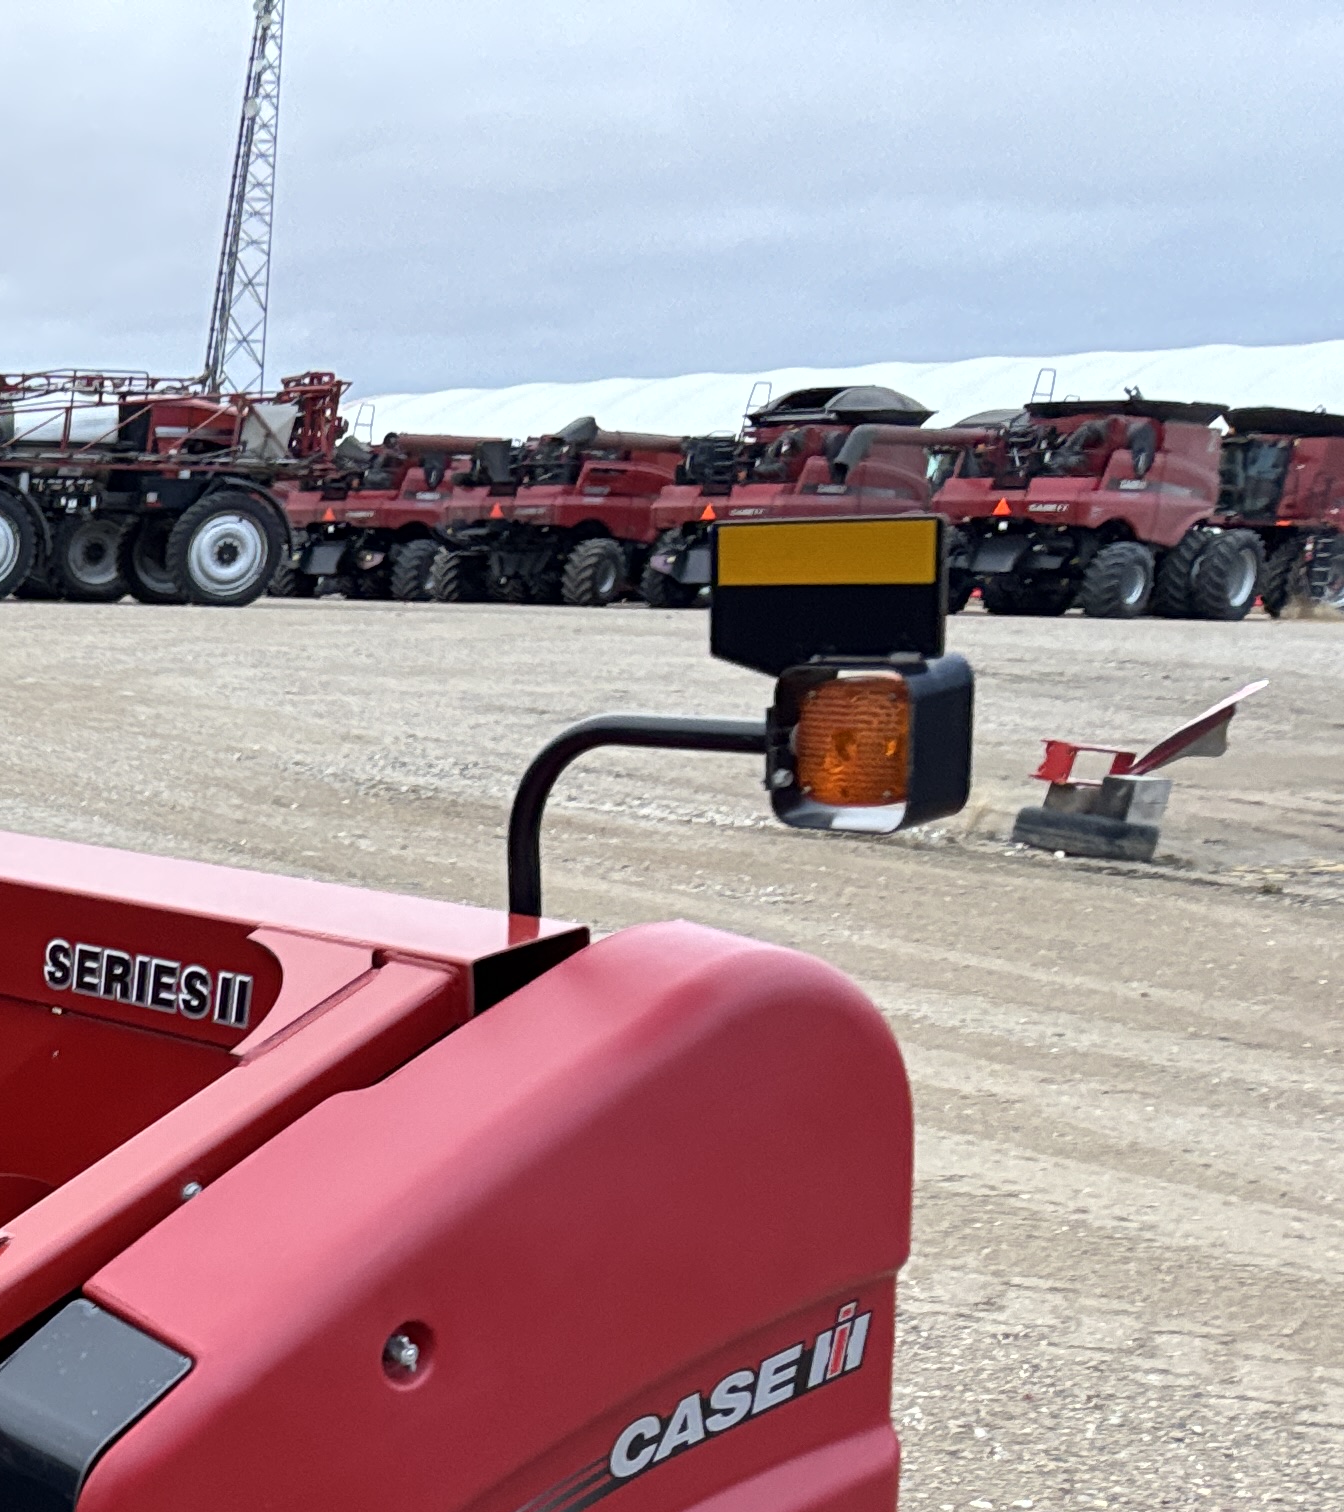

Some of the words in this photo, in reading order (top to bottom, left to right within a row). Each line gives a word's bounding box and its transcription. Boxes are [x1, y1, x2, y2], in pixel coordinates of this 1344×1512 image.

[44, 939, 210, 1019] SERIES
[213, 971, 253, 1030] II
[610, 1341, 804, 1479] CASE
